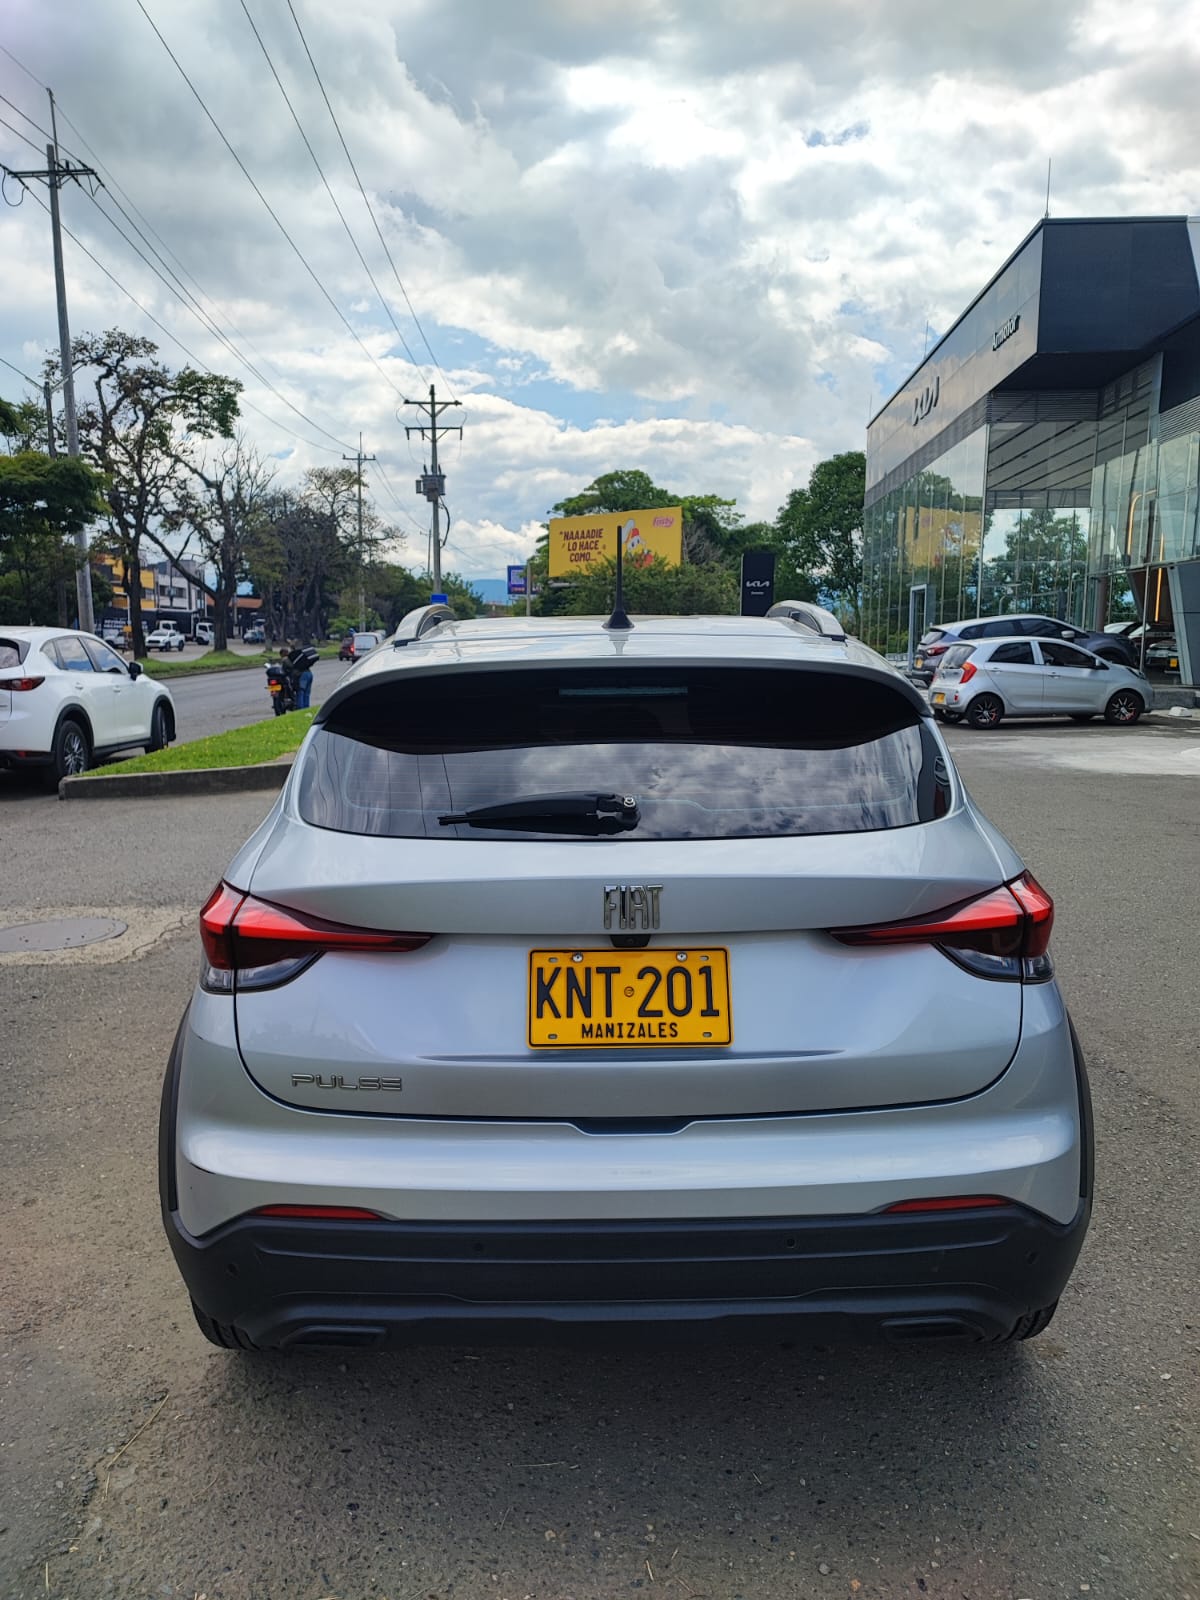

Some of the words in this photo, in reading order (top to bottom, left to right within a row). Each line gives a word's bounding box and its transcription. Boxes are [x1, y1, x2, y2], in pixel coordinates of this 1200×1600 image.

[567, 542, 578, 552] LO
[579, 540, 600, 551] HACE
[746, 580, 770, 588] KIA
[604, 884, 663, 930] FIAT
[536, 966, 621, 1019] KNT
[636, 965, 720, 1018] 201
[581, 1022, 679, 1040] MANIZALES
[291, 1072, 403, 1092] PULSE
